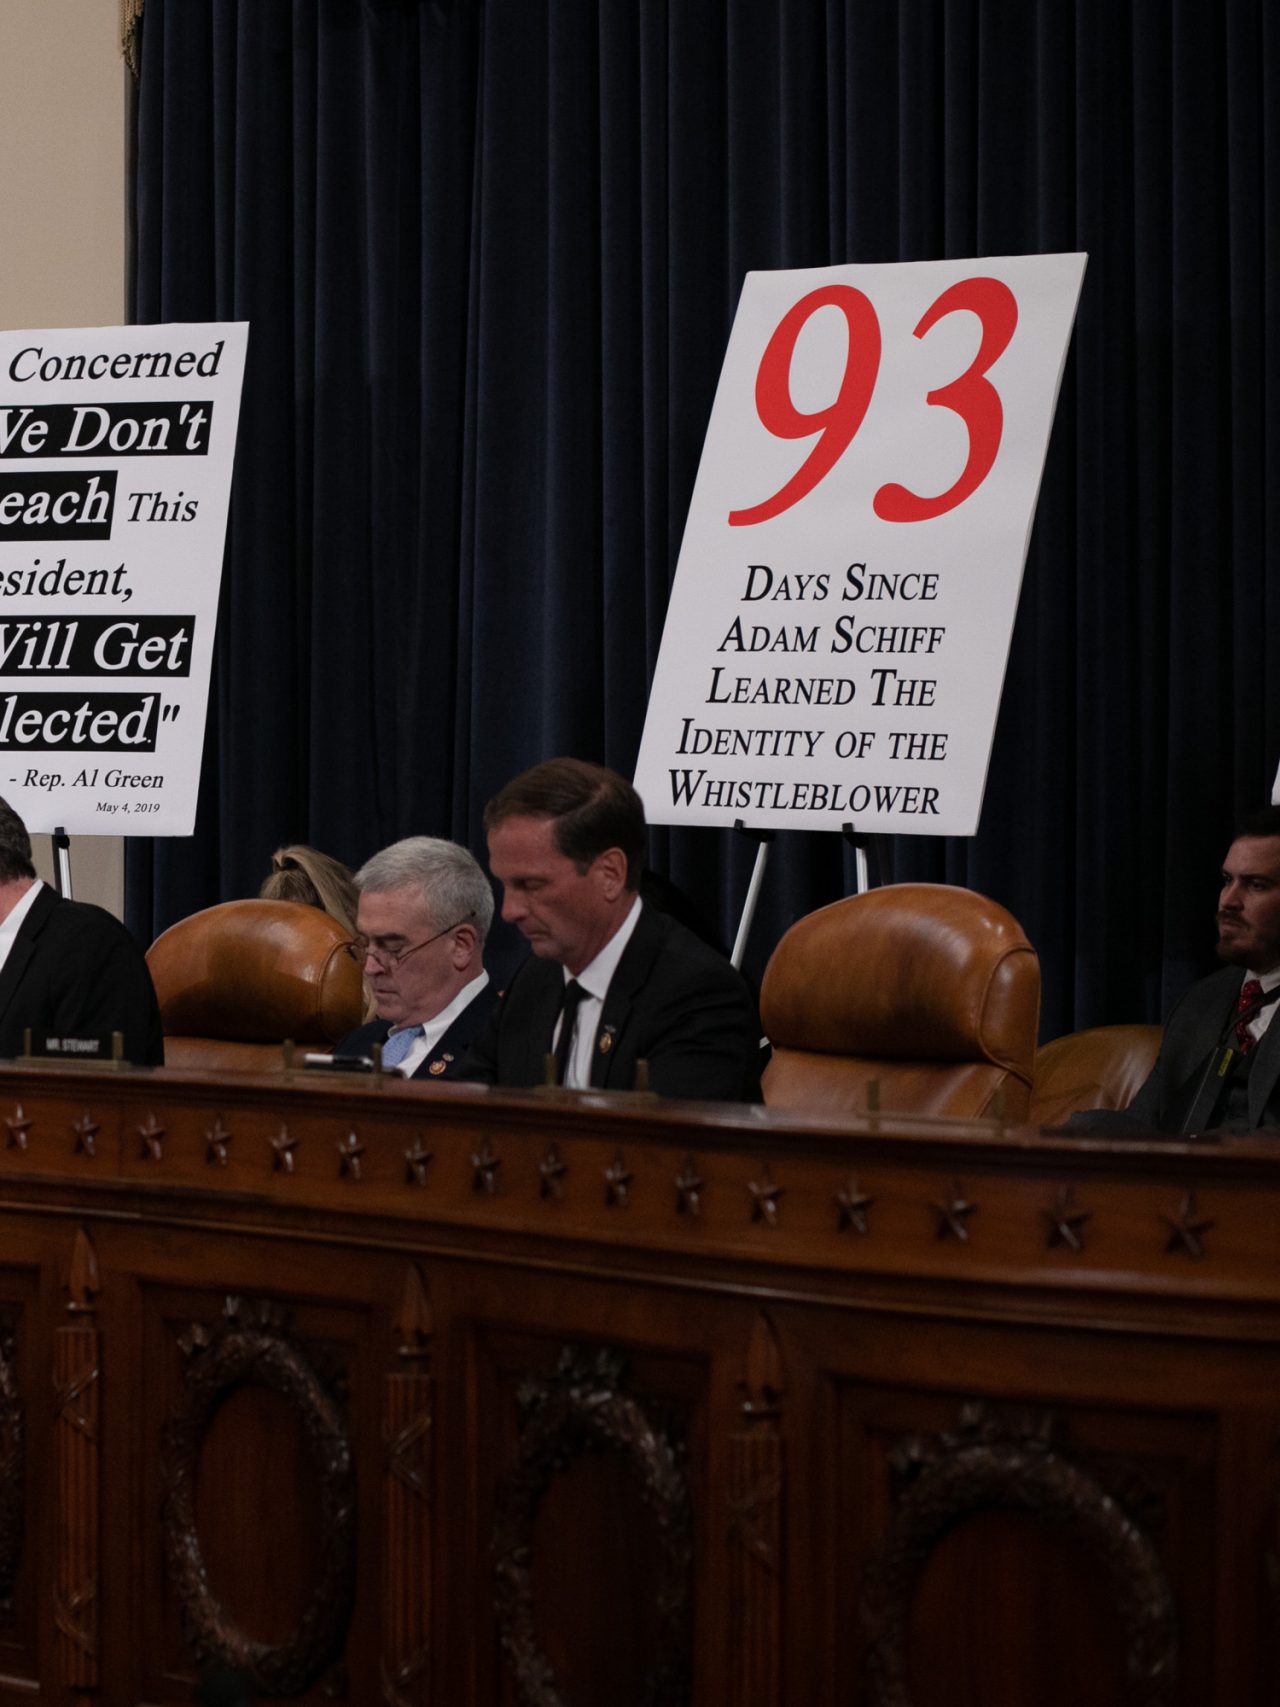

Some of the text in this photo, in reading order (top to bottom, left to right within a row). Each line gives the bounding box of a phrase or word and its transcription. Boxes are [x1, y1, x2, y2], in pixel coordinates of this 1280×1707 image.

[9, 341, 224, 382] Concerned
[728, 276, 1019, 527] 93
[61, 404, 208, 453] Don't
[128, 492, 198, 521] This
[94, 622, 189, 671] Get
[23, 768, 65, 791] Rep.
[72, 769, 98, 786] Al
[104, 769, 165, 789] Green
[96, 802, 161, 815] May 4, 2019
[47, 1039, 60, 1050] MR.
